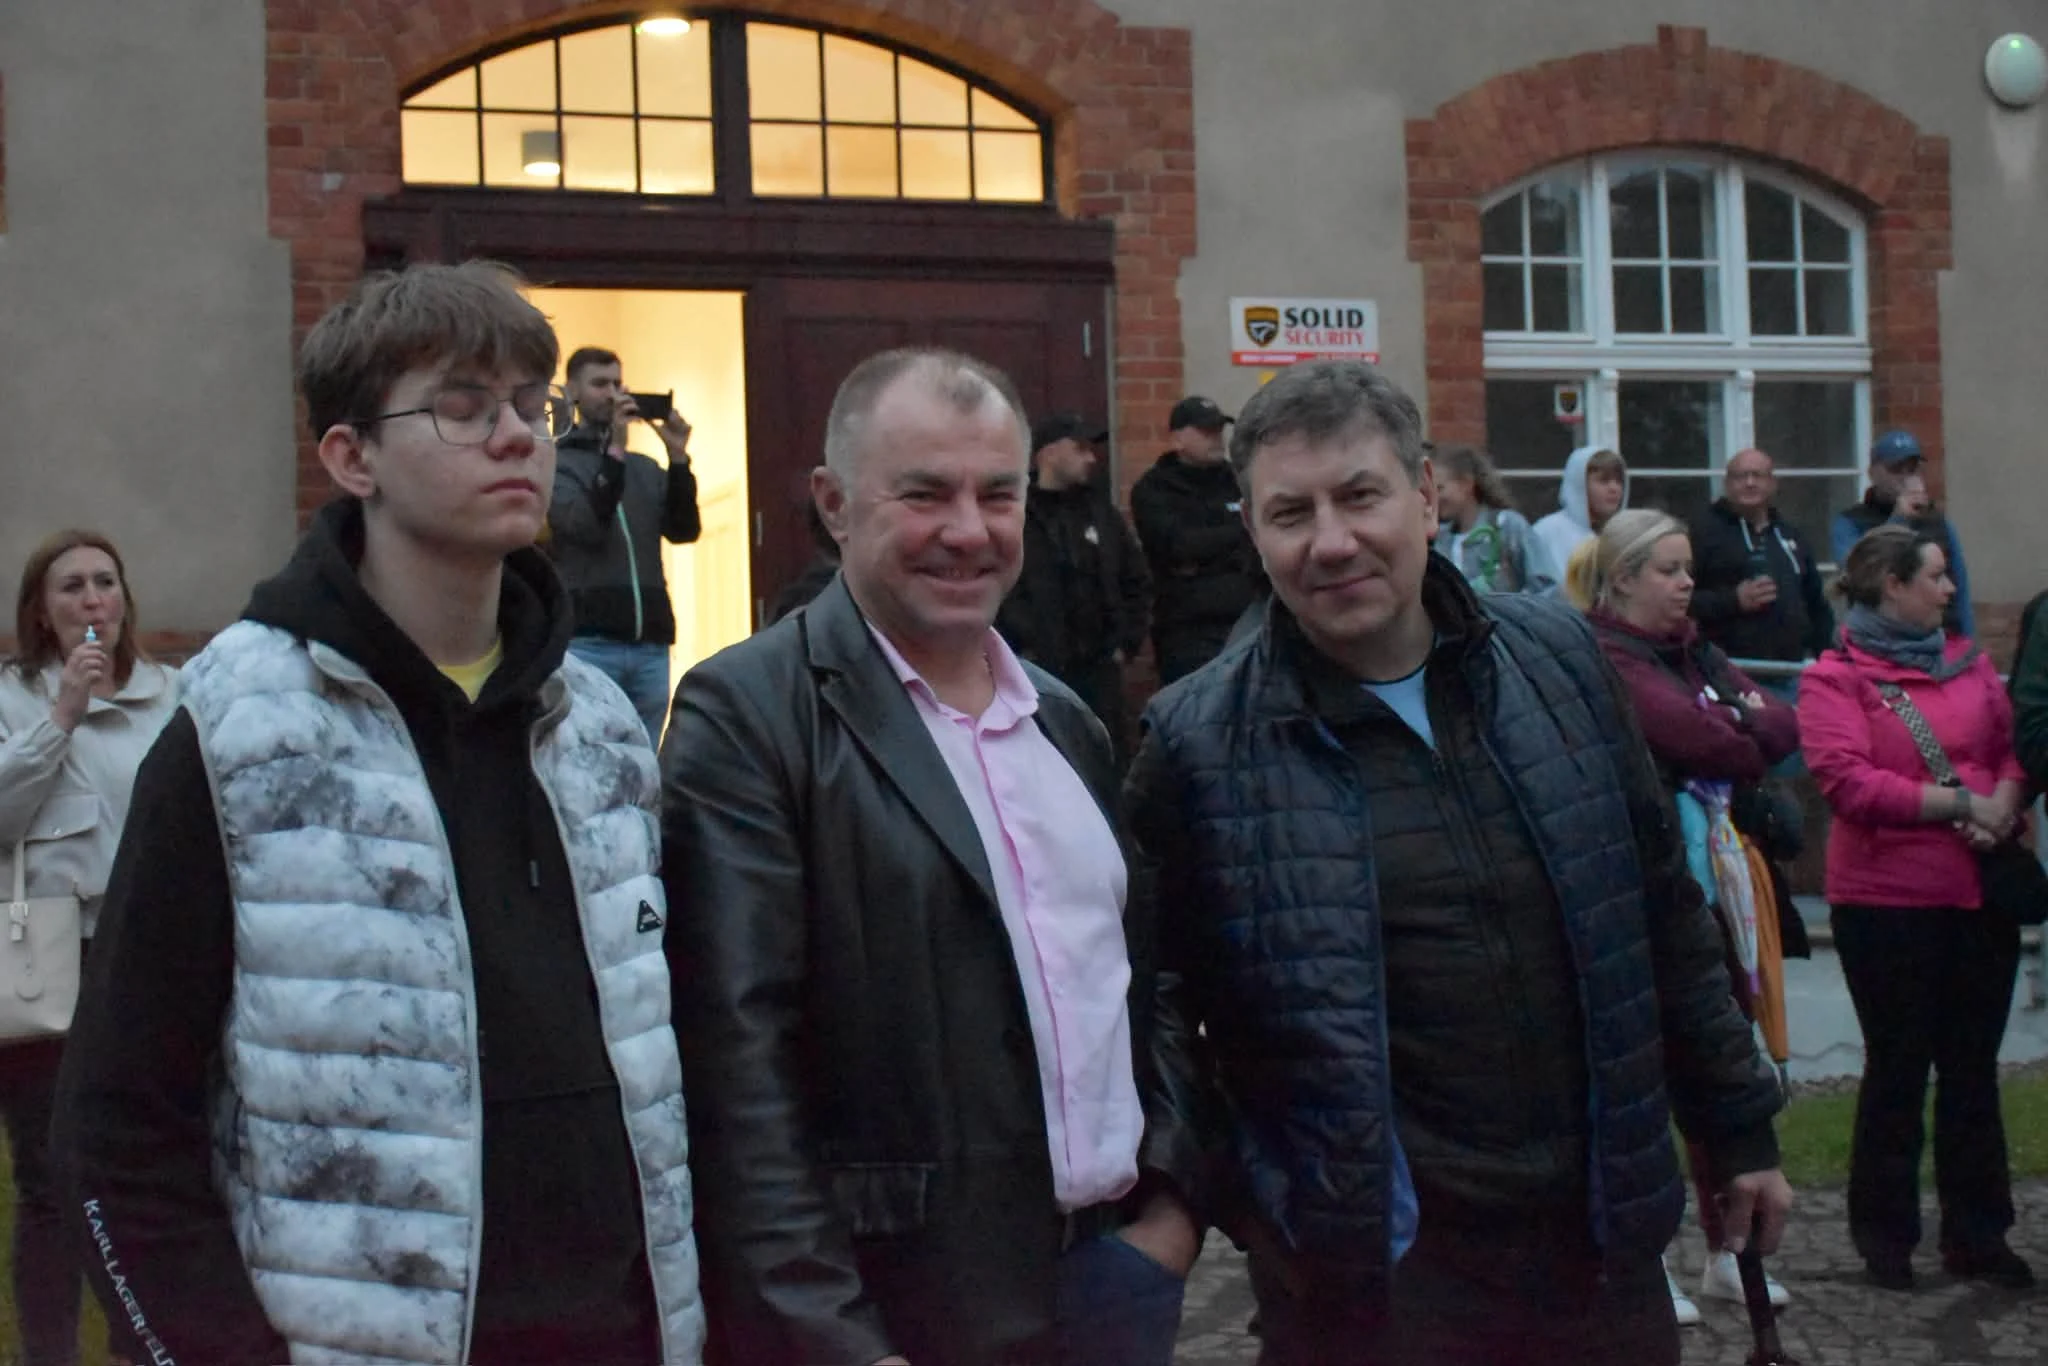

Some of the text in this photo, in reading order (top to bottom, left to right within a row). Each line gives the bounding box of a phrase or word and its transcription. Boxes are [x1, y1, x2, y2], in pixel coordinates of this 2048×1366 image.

[1284, 307, 1363, 329] SOLID
[1284, 330, 1364, 345] SECURITY
[83, 1199, 113, 1260] KARL
